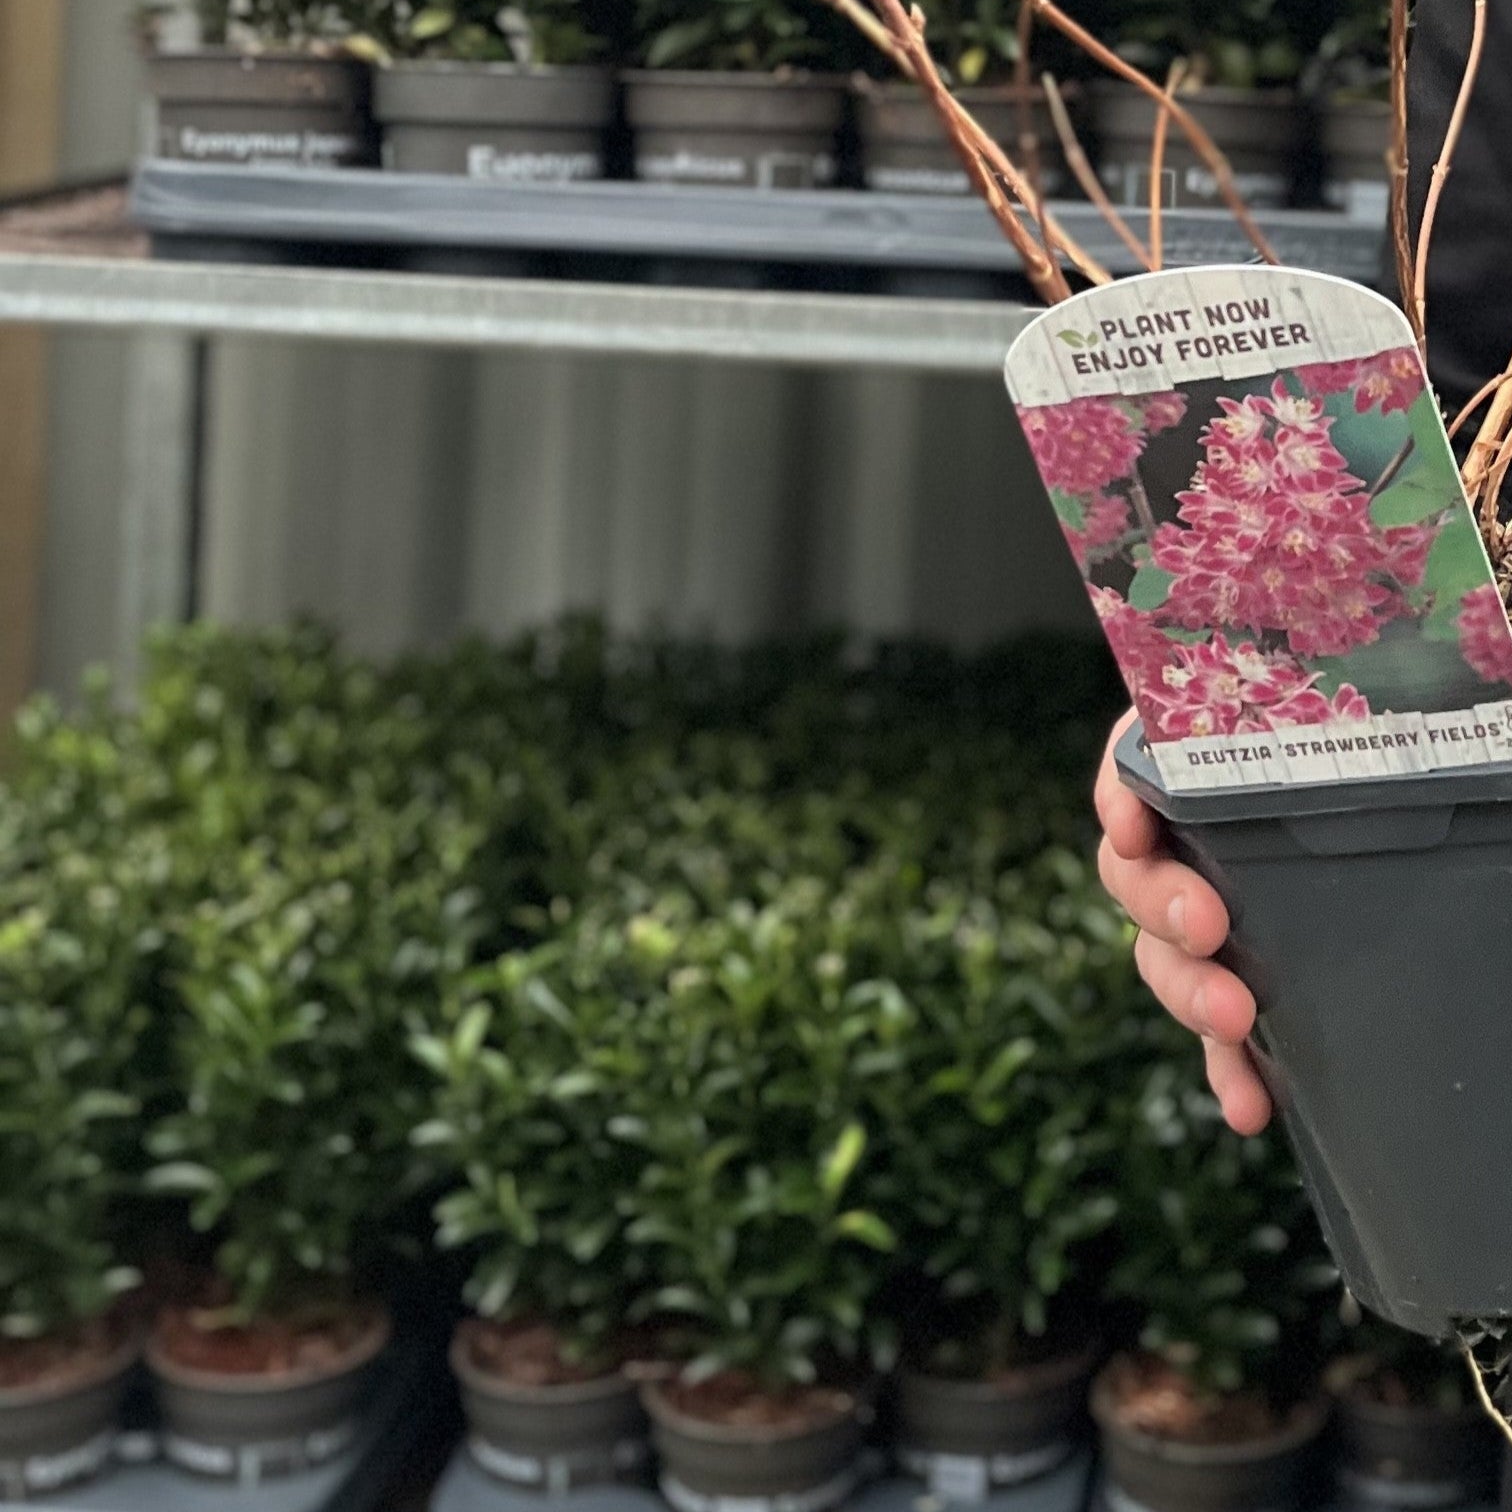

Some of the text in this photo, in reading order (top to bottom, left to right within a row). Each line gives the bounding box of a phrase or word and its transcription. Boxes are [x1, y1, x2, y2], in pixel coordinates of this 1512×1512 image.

[1100, 297, 1271, 342] PLANT NOW
[1071, 323, 1312, 375] ENJOY FOREVER
[1187, 721, 1505, 766] DEUTZIA 'STRAWBERRY FIELDS'
